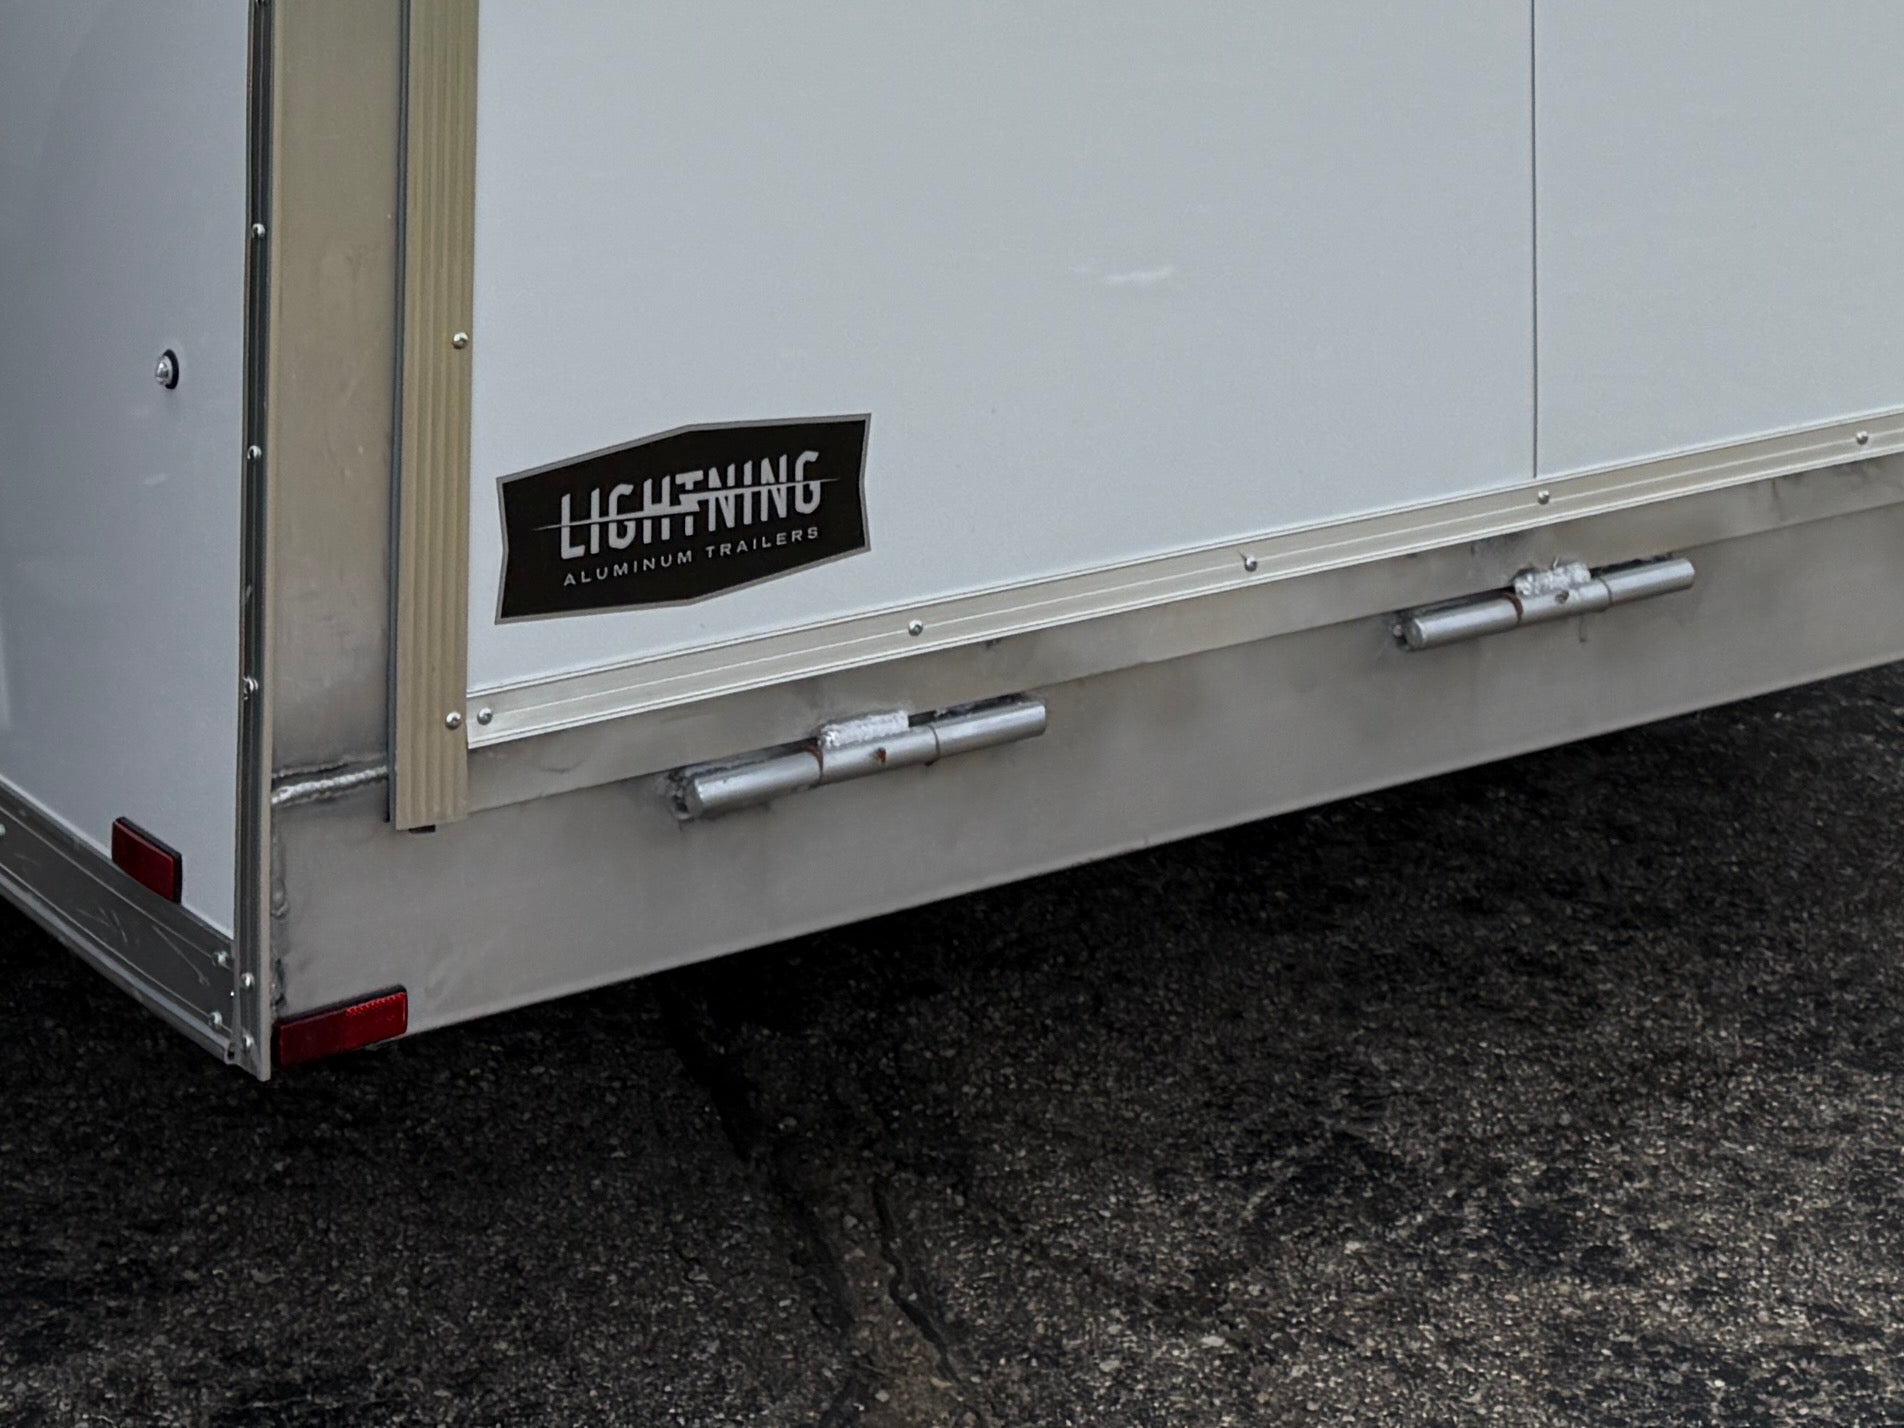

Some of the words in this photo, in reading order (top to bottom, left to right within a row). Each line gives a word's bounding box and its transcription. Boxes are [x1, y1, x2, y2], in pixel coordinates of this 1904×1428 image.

[559, 450, 822, 560] LIGHTNING
[563, 549, 693, 587] ALUMINUM
[705, 526, 820, 559] TRAILERS
